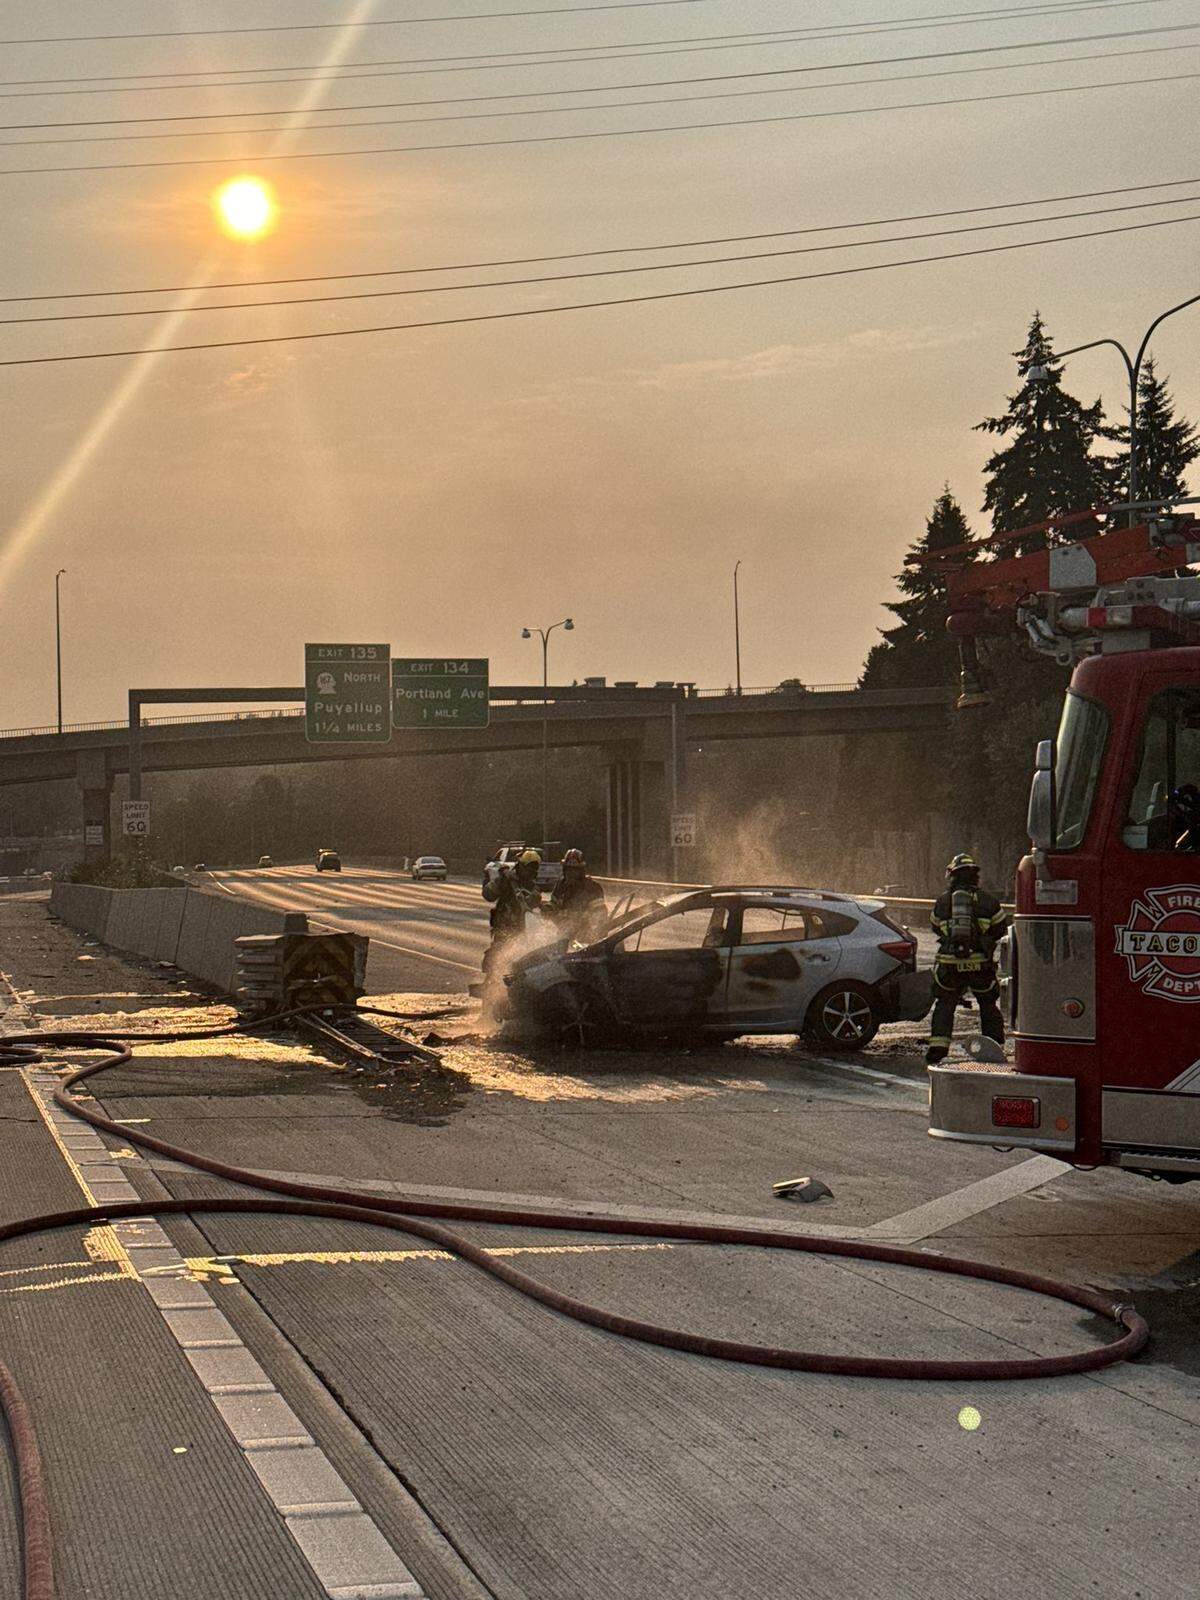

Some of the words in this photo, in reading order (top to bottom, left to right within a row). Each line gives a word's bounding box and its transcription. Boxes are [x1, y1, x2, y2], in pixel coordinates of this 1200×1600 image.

[318, 648, 343, 657] EXIT
[350, 647, 377, 659] 135
[410, 663, 433, 672] EXIT
[443, 662, 469, 673] 134
[343, 671, 381, 682] NORTH
[395, 688, 452, 699] Portland
[460, 688, 485, 699] Ave
[314, 702, 382, 715] Puyallup
[434, 709, 459, 717] MILE
[347, 723, 382, 732] MILES
[127, 821, 146, 832] 60
[674, 833, 692, 844] 60
